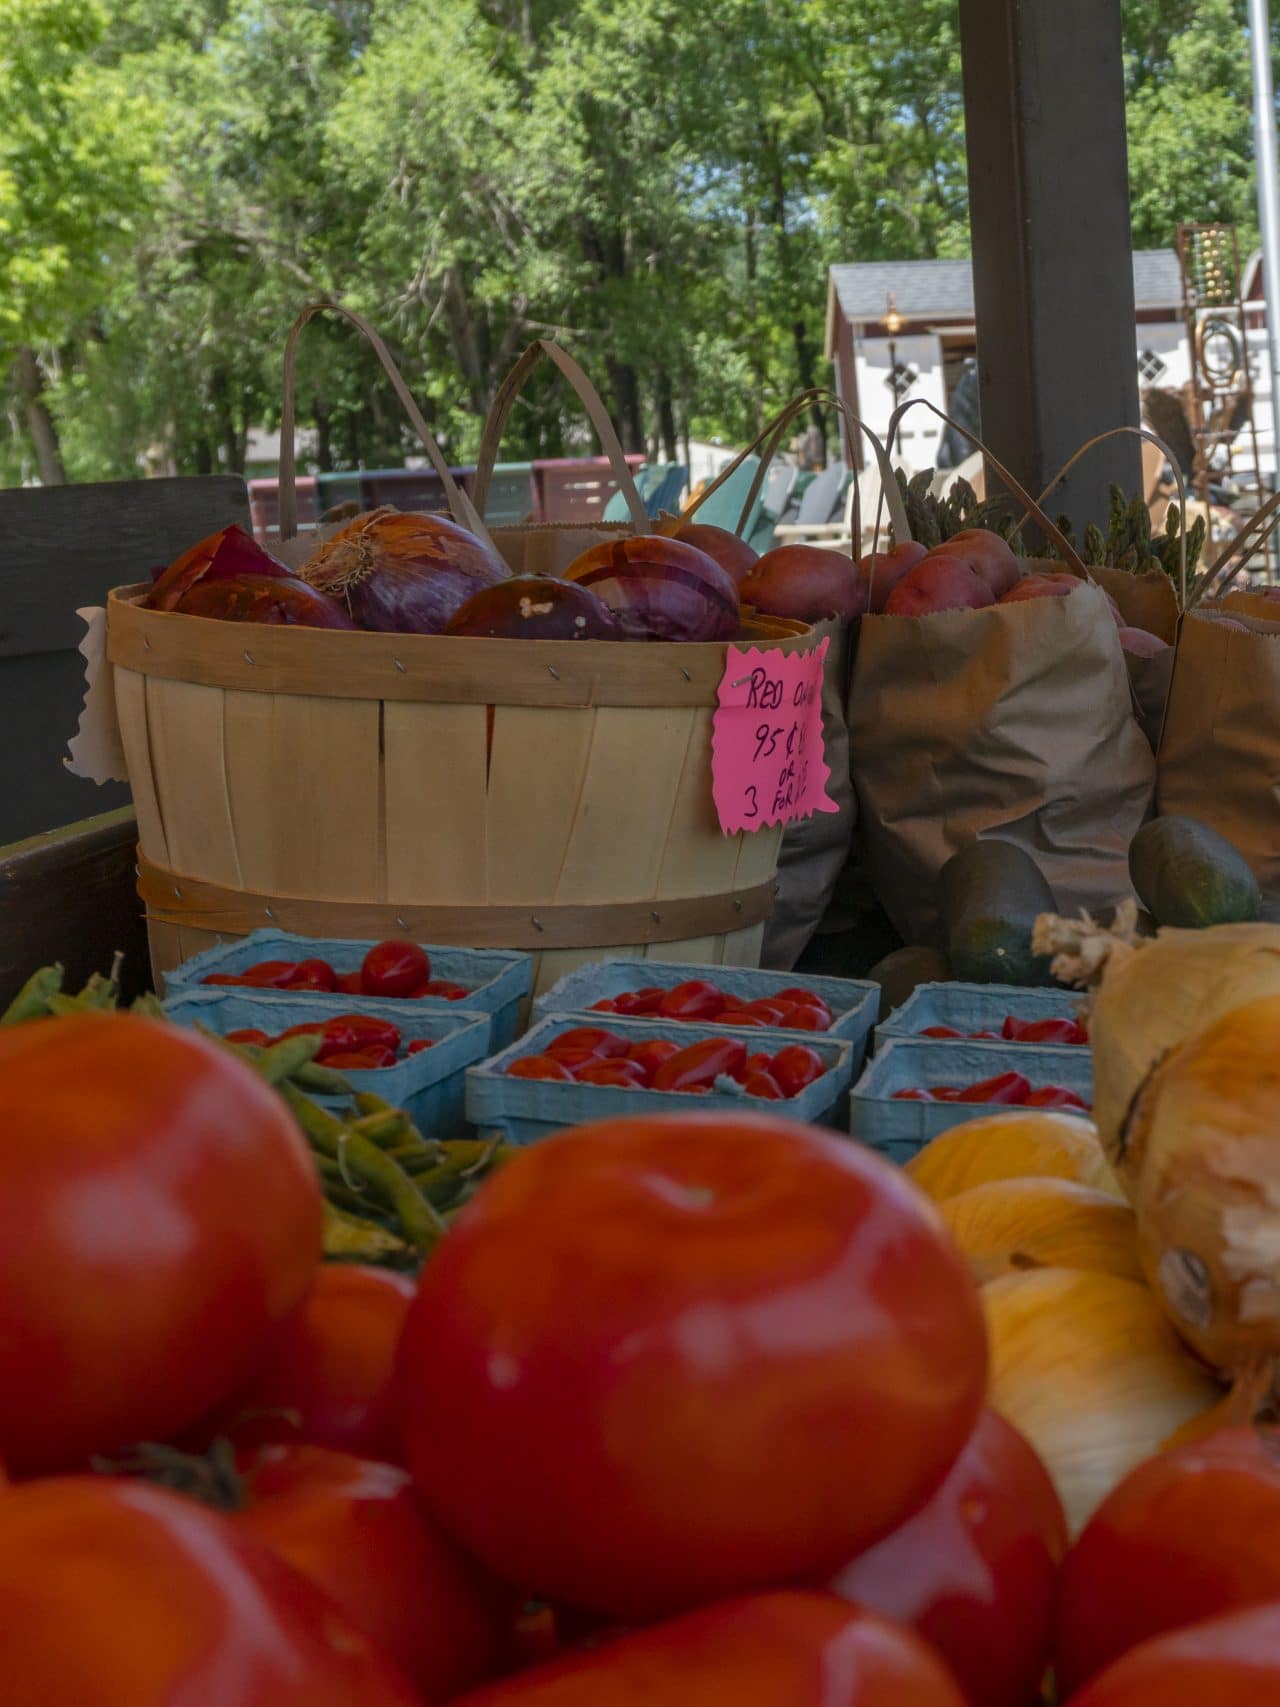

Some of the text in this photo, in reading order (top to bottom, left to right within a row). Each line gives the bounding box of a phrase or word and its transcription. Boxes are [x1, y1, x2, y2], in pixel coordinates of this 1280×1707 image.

[745, 667, 783, 708] RED
[779, 760, 795, 787] OR
[743, 782, 792, 818] 3 FOR
